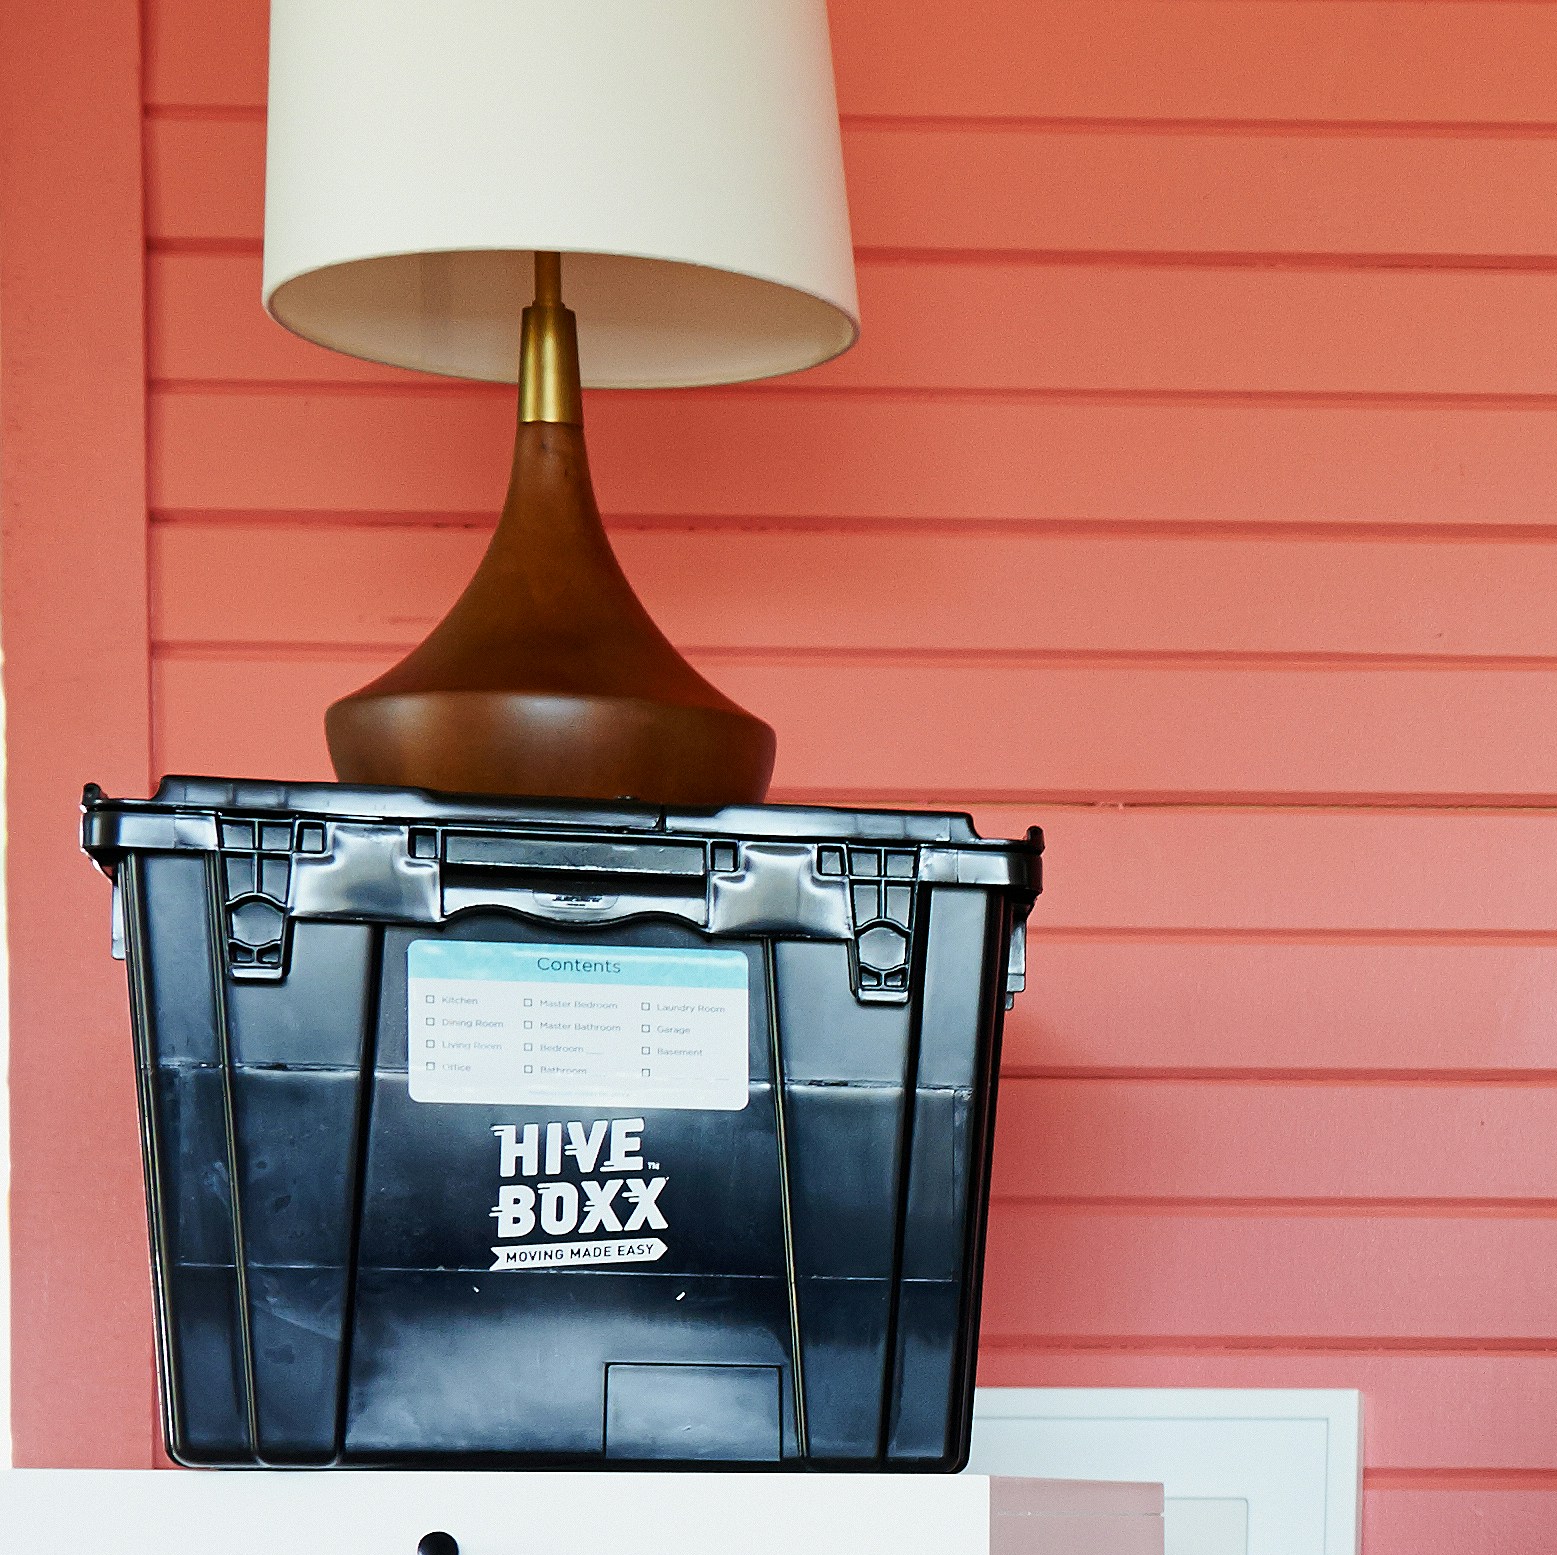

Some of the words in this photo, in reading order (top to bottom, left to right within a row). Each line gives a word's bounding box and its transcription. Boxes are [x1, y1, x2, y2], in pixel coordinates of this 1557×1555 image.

[537, 957, 621, 974] Contents
[442, 996, 478, 1005] Kitchen
[540, 999, 571, 1008] Master
[657, 1003, 695, 1014] Laundry
[442, 1019, 473, 1029] Dining
[475, 1020, 503, 1028] Room
[540, 1022, 571, 1031] Master
[574, 1023, 621, 1032] Bathroom
[657, 1026, 690, 1035] Garage
[442, 1042, 472, 1051] Living
[474, 1042, 501, 1050] Room
[540, 1044, 584, 1052] Bedroom
[658, 1048, 702, 1056] Basement
[442, 1063, 471, 1072] Office
[540, 1067, 586, 1075] Bathroom
[491, 1117, 645, 1177] HIVE
[489, 1177, 669, 1238] BOXX
[506, 1248, 564, 1262] MOVING
[571, 1246, 611, 1258] MADE
[618, 1244, 654, 1256] EASY
